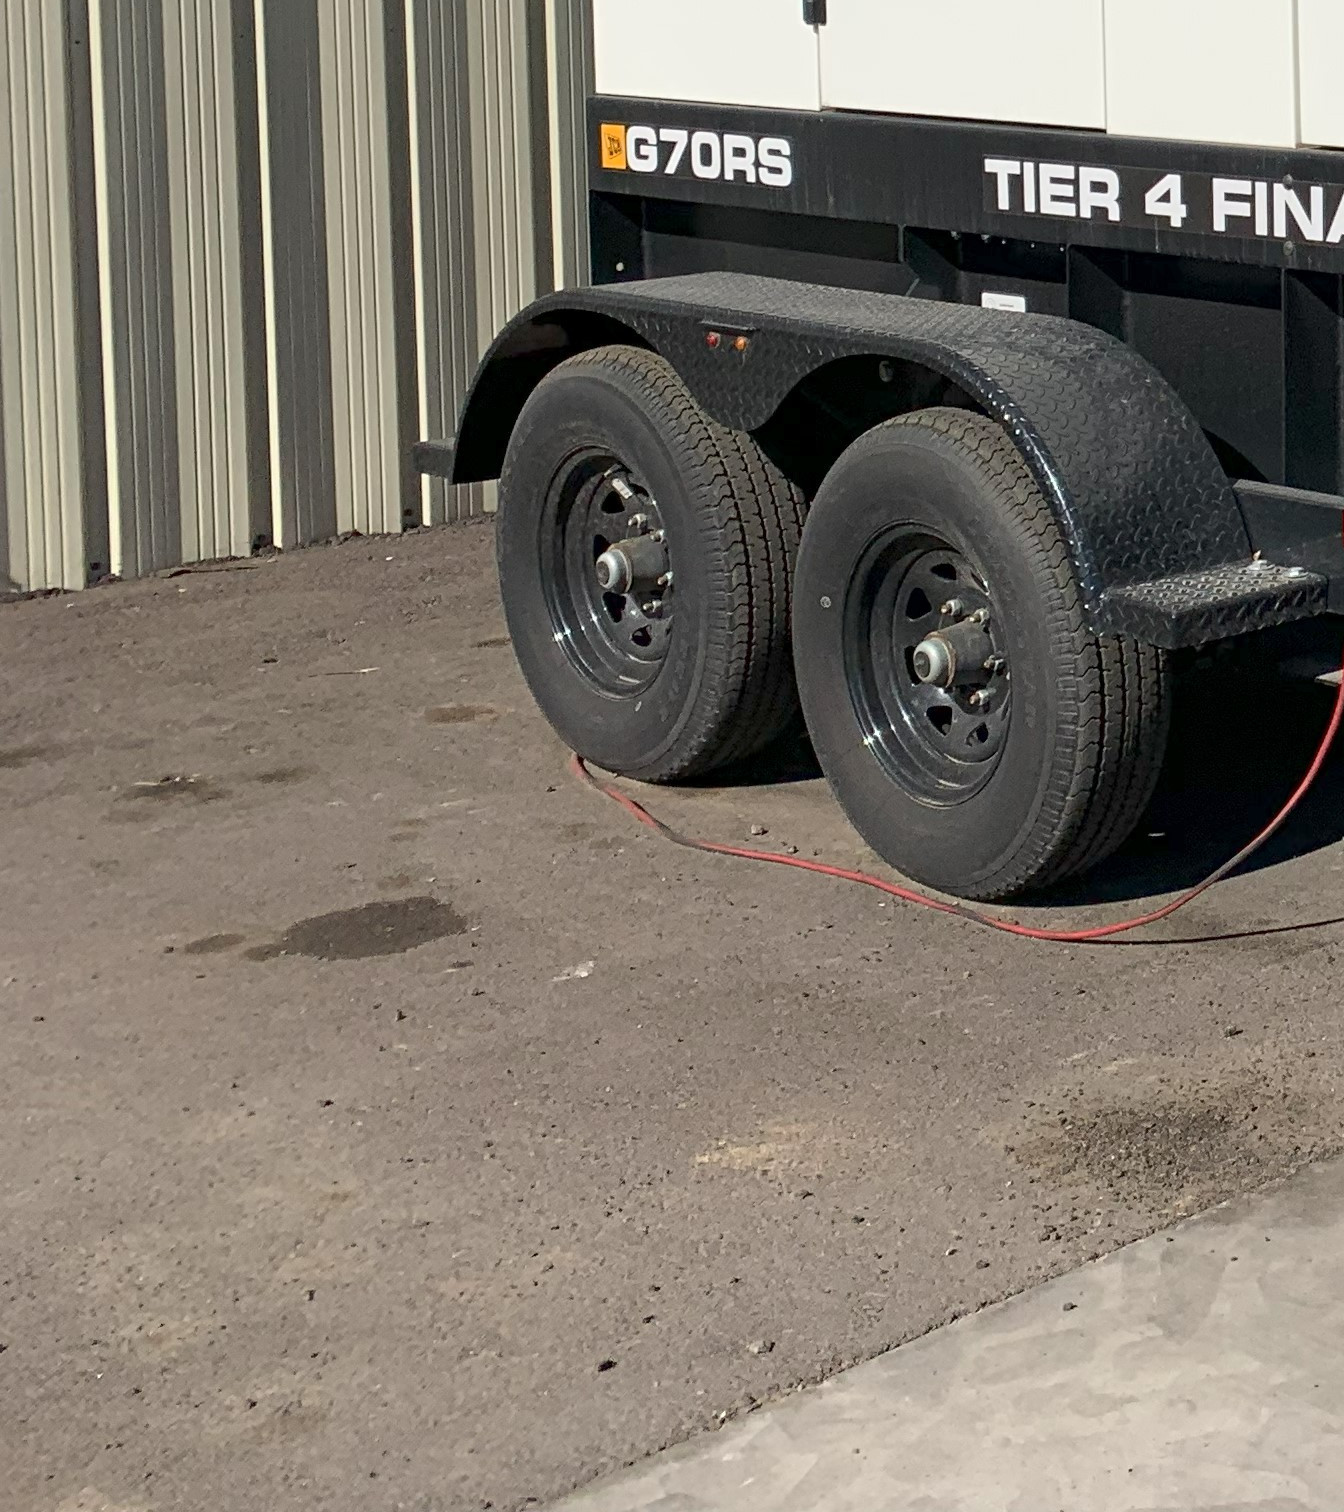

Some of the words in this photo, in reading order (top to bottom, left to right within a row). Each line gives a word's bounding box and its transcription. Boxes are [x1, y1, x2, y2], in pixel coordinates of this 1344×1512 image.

[626, 125, 792, 187] G70RS
[984, 158, 1121, 222] TIER
[1145, 174, 1187, 228] 4
